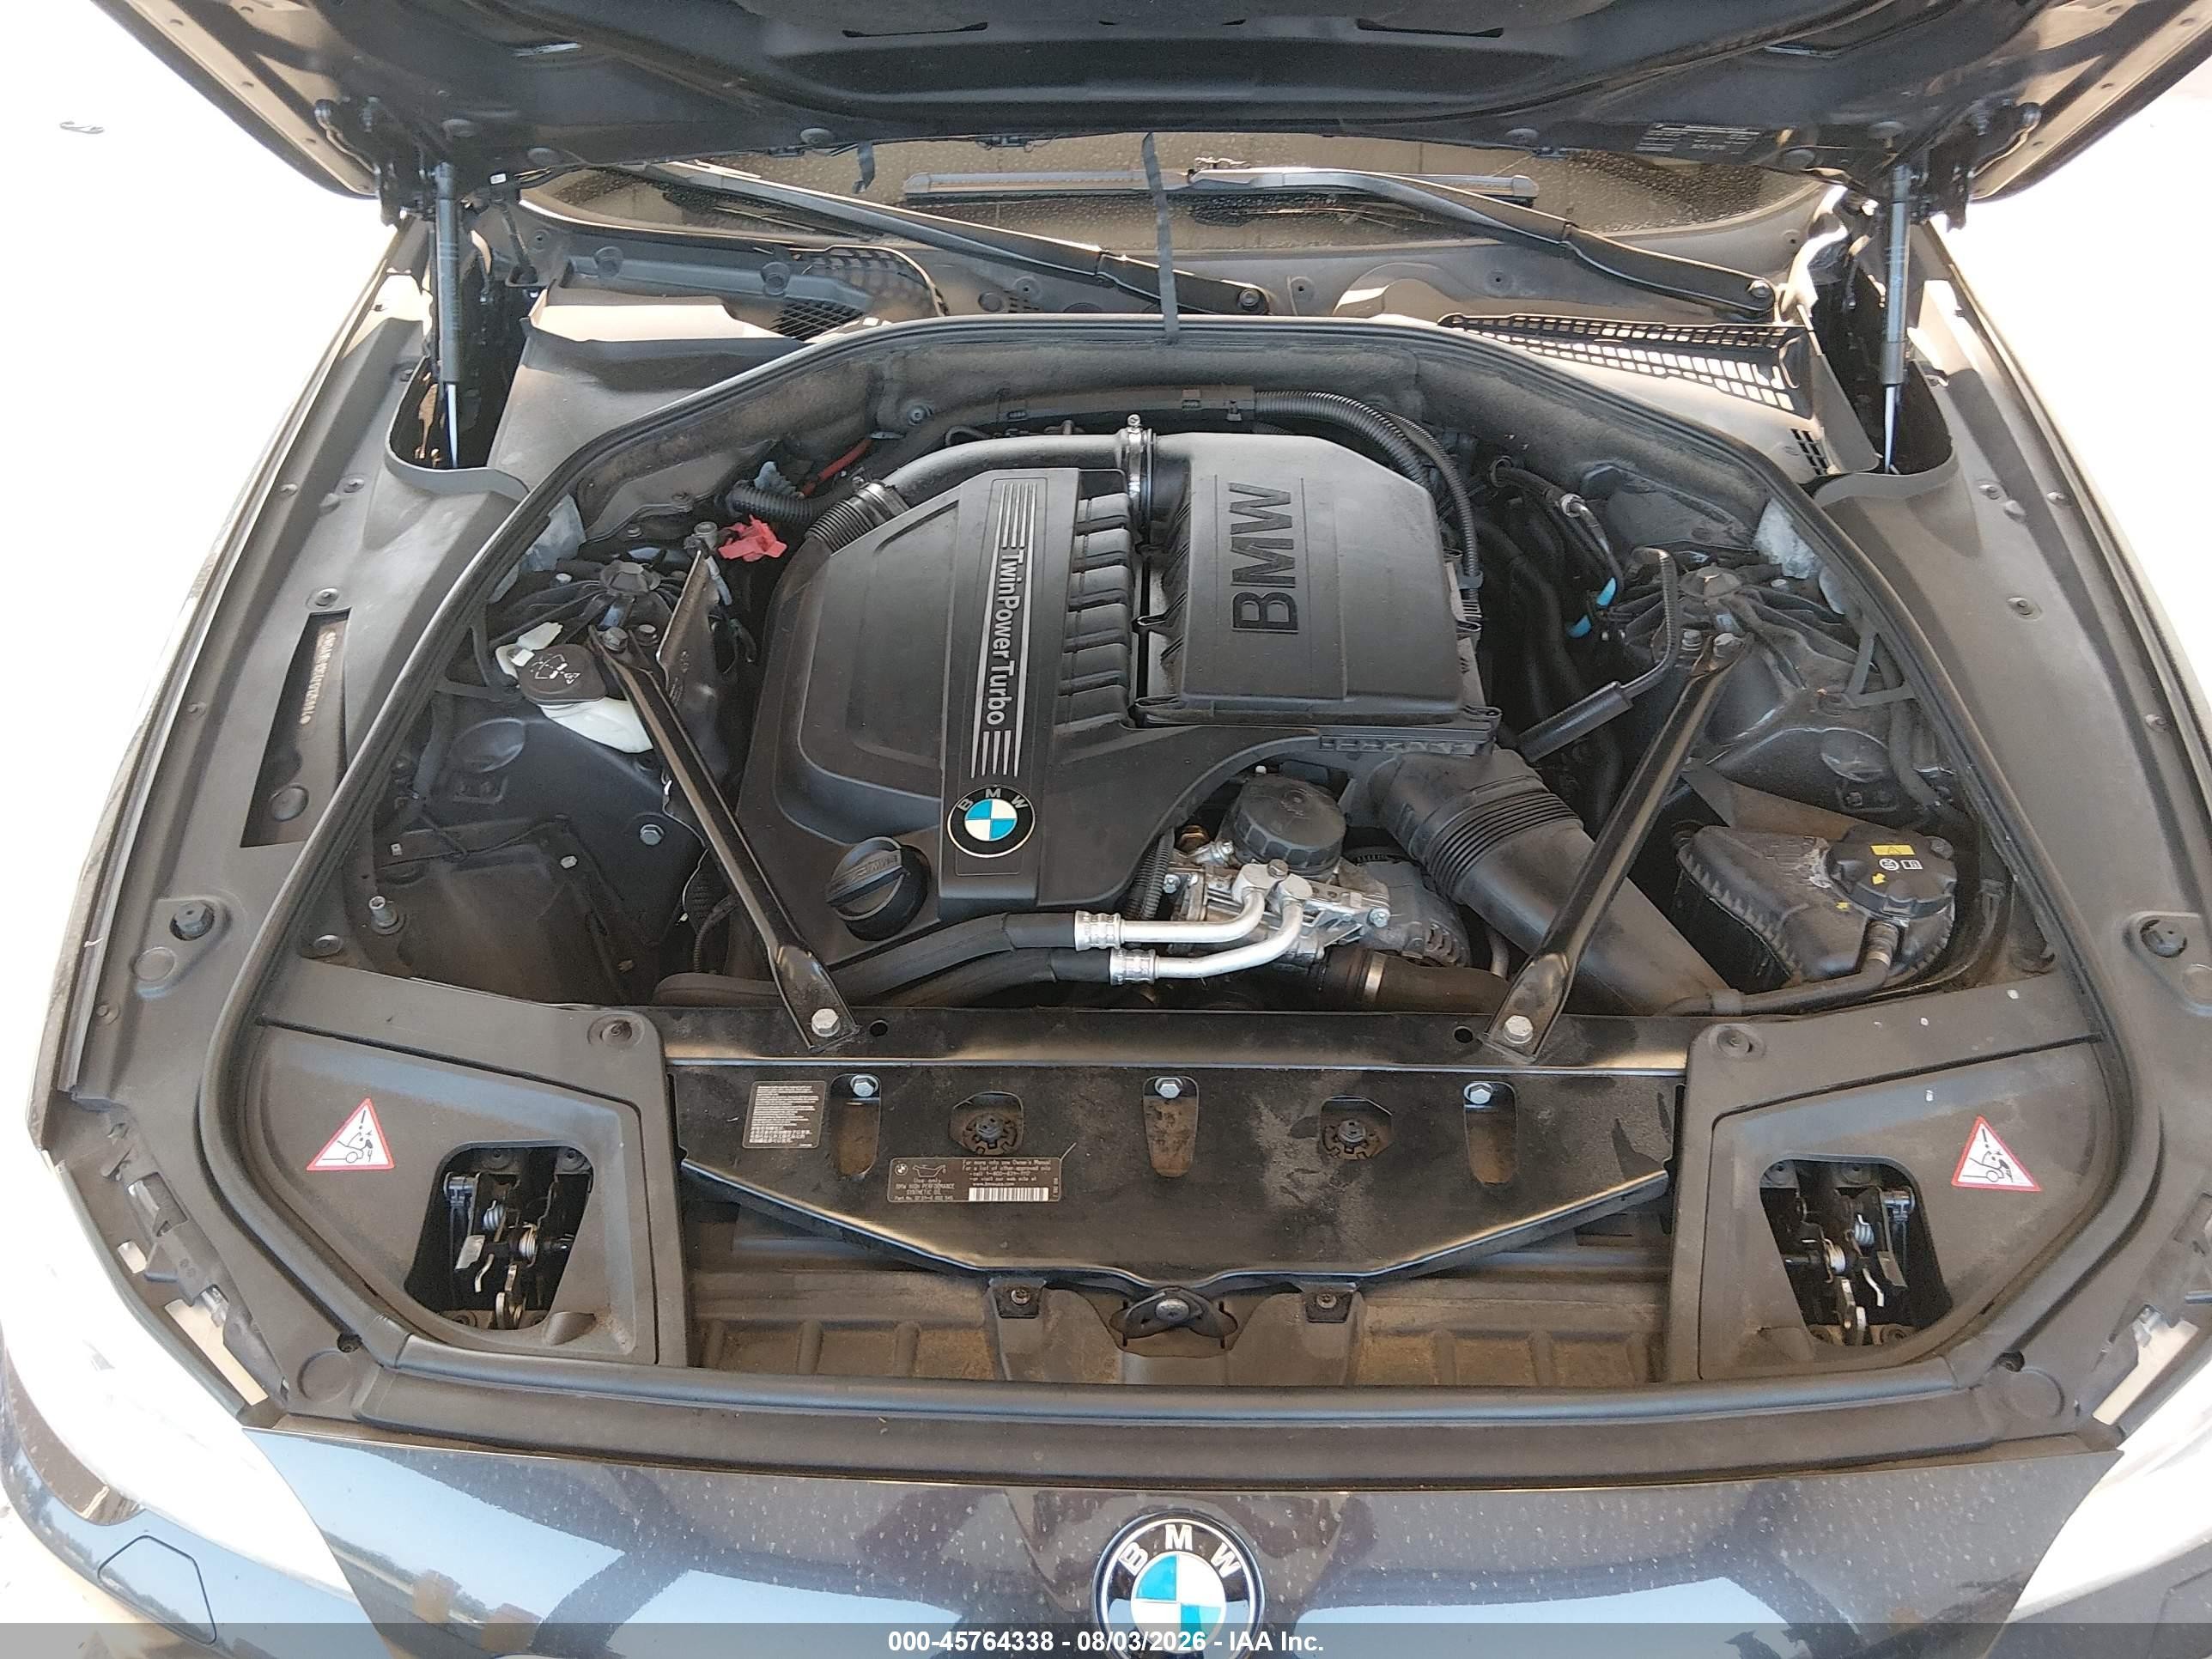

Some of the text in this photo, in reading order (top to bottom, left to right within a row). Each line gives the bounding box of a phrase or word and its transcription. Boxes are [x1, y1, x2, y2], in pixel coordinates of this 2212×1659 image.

[1229, 483, 1298, 635] BMW
[987, 549, 1024, 726] TwinPower Turbo
[957, 788, 1029, 811] BMW
[1118, 1524, 1242, 1578] BMW
